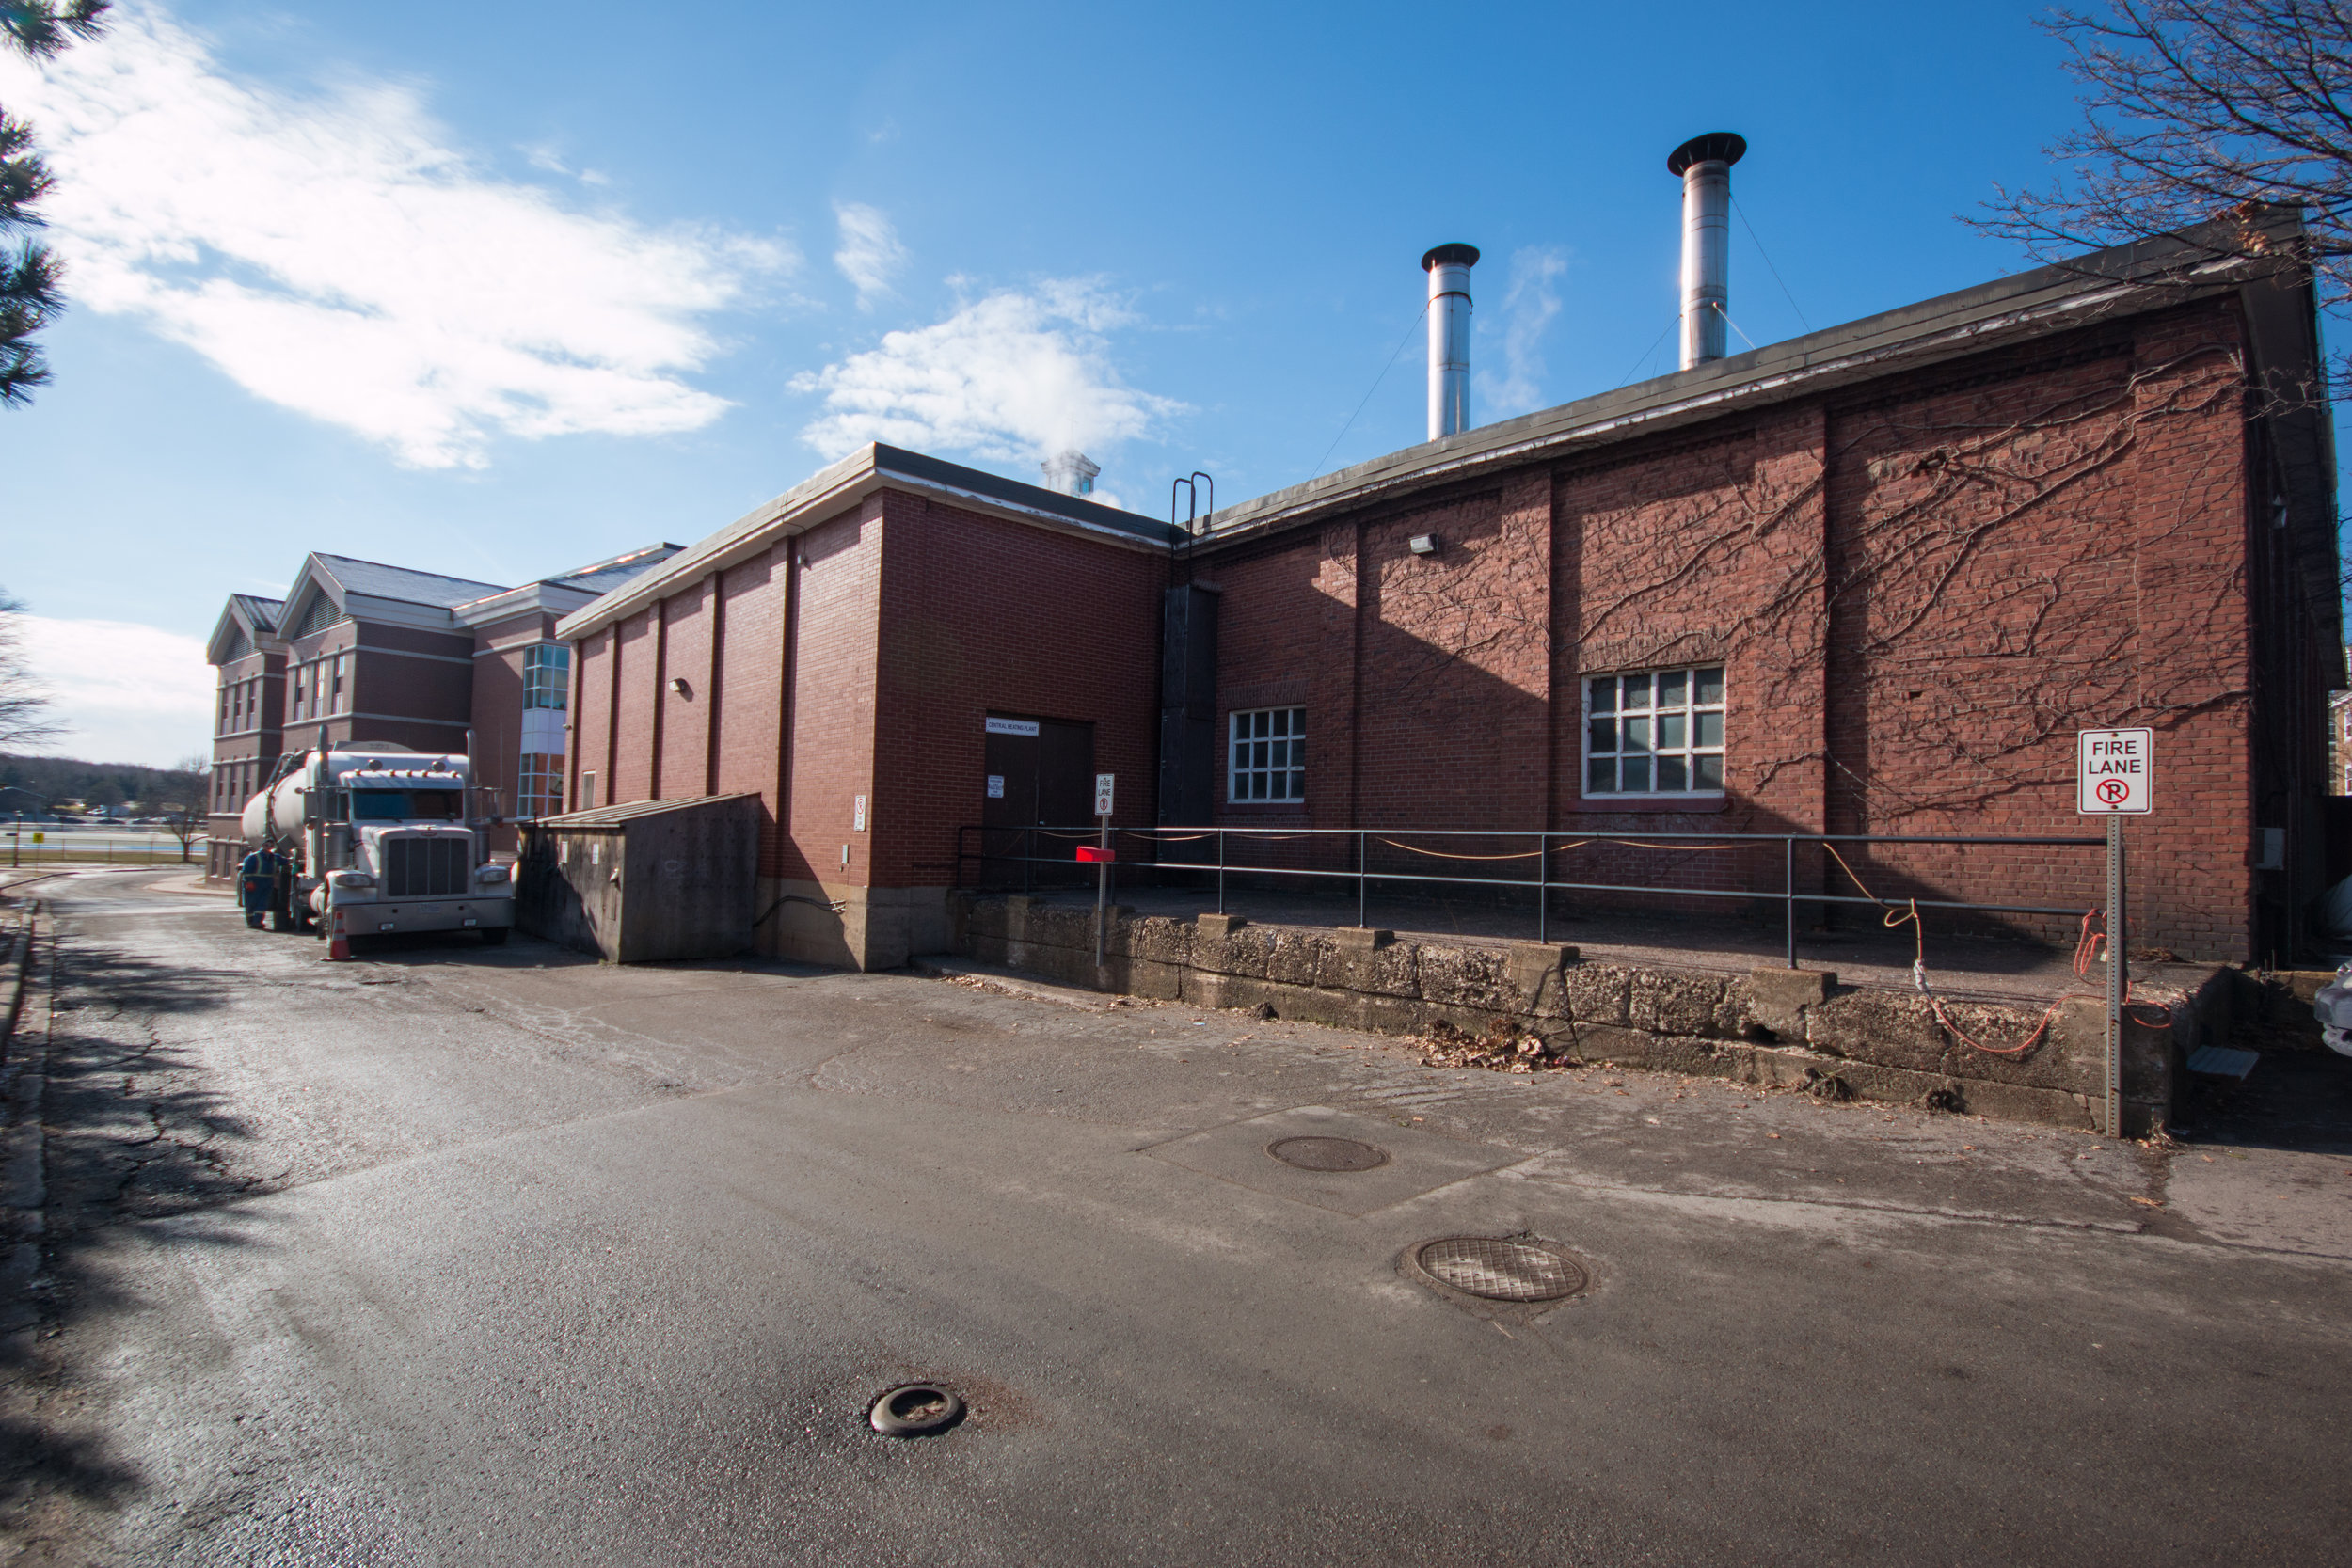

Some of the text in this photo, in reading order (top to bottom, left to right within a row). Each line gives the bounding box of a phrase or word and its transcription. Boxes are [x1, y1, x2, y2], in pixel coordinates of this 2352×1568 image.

[2092, 740, 2137, 755] FIRE
[2089, 759, 2141, 774] LANE
[1099, 779, 1111, 787] FIRE
